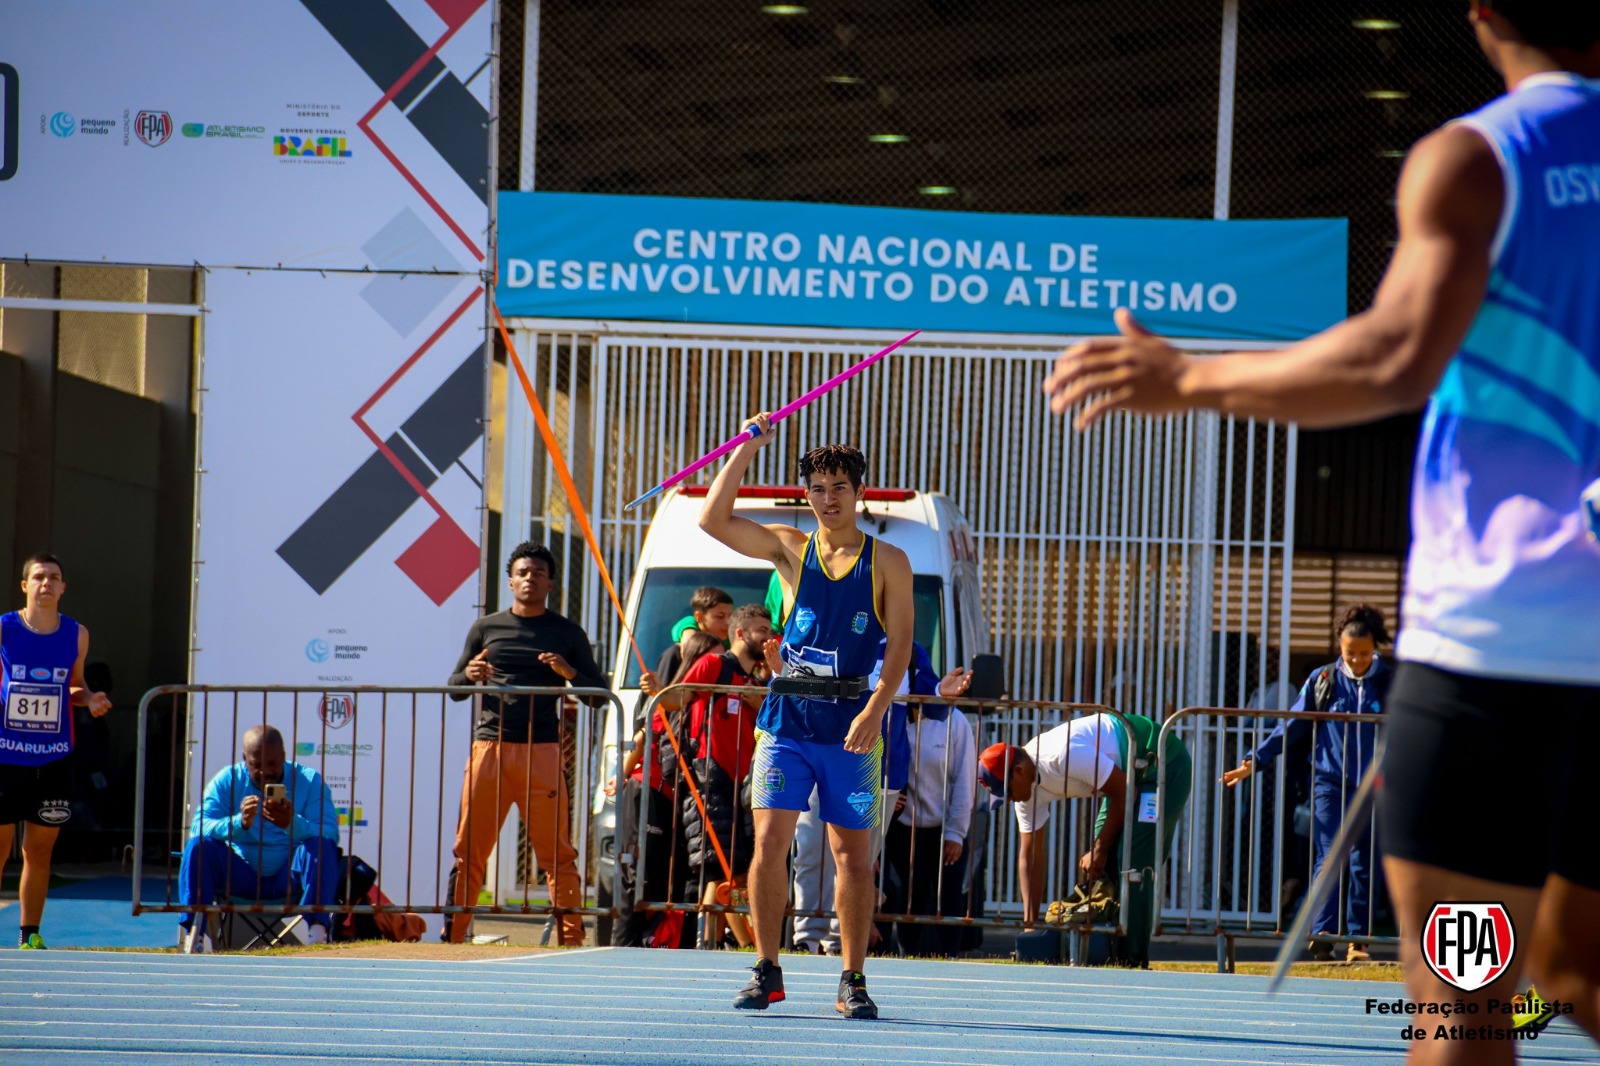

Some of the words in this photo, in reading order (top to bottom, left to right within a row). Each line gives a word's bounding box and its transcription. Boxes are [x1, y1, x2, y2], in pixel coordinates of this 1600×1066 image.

[81, 118, 116, 127] pequeno
[81, 126, 109, 135] mundo
[141, 114, 166, 140] FPA
[274, 136, 352, 157] BRASIL
[633, 228, 802, 262] CENTRO
[818, 233, 1032, 271] NACIONAL
[1049, 243, 1099, 274] DE
[506, 258, 914, 301] DESENVOLVIMENTO
[930, 273, 989, 304] DO
[1004, 276, 1238, 314] ATLETISMO
[335, 644, 368, 652] pequeno
[335, 652, 361, 660] mundo
[17, 697, 50, 716] 811
[0, 737, 69, 754] GUARULHOS
